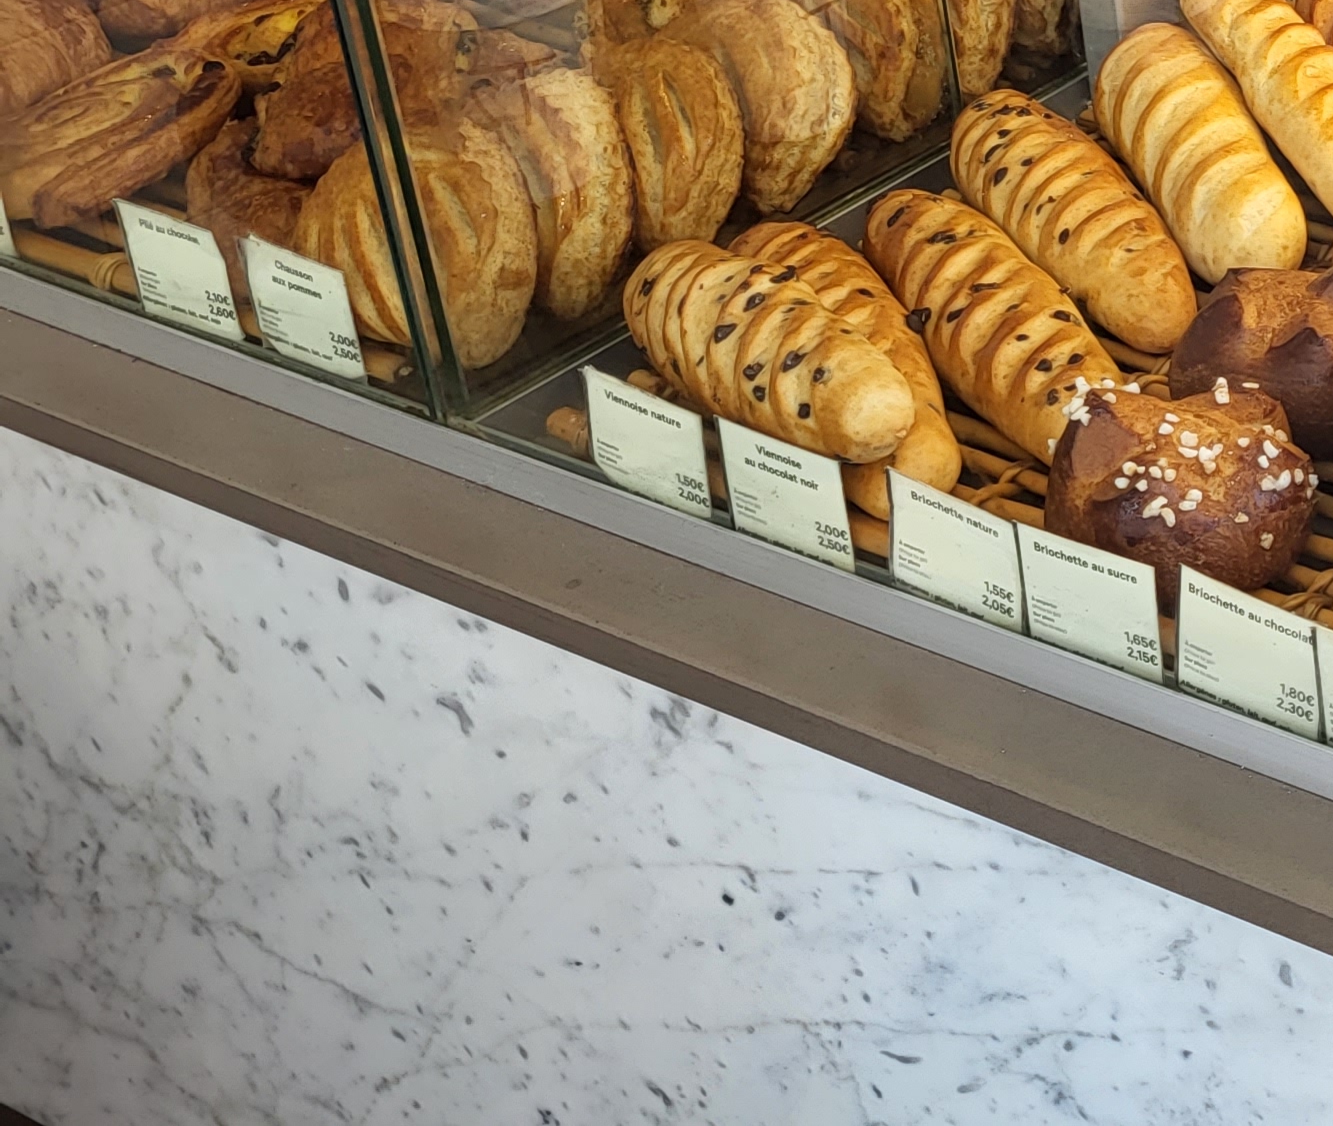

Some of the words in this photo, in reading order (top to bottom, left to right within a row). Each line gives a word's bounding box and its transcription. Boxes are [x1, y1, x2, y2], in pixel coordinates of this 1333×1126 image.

[275, 260, 313, 282] Chausson
[205, 290, 230, 306] 2,10€
[272, 276, 286, 286] aux
[288, 281, 322, 299] pommes
[329, 331, 358, 349] 2,00€
[332, 345, 361, 362] 2,50€
[604, 389, 648, 415] Viennoise
[651, 411, 681, 428] nature
[755, 444, 802, 470] Viennoise
[676, 473, 705, 492] 1,50€
[744, 457, 755, 467] au
[758, 462, 798, 483] chocolat
[800, 478, 819, 490] noir
[678, 487, 710, 508] 2,00€
[911, 491, 963, 521] Briochette
[966, 517, 999, 537] nature
[815, 521, 848, 541] 2,00€
[818, 535, 850, 555] 2,50€
[1034, 541, 1088, 568] Briochette
[1091, 563, 1104, 574] au
[1107, 568, 1137, 584] sucre
[984, 581, 1014, 603] 1,55€
[982, 595, 1014, 618] 2,05€
[1188, 583, 1245, 616] Briochette
[1248, 612, 1261, 623] au
[1264, 619, 1314, 646] chocolat
[1124, 631, 1157, 651] 1,65€
[1127, 647, 1158, 666] 2,15€
[1280, 683, 1315, 707] 1,80€
[1276, 697, 1314, 722] 2,30€
